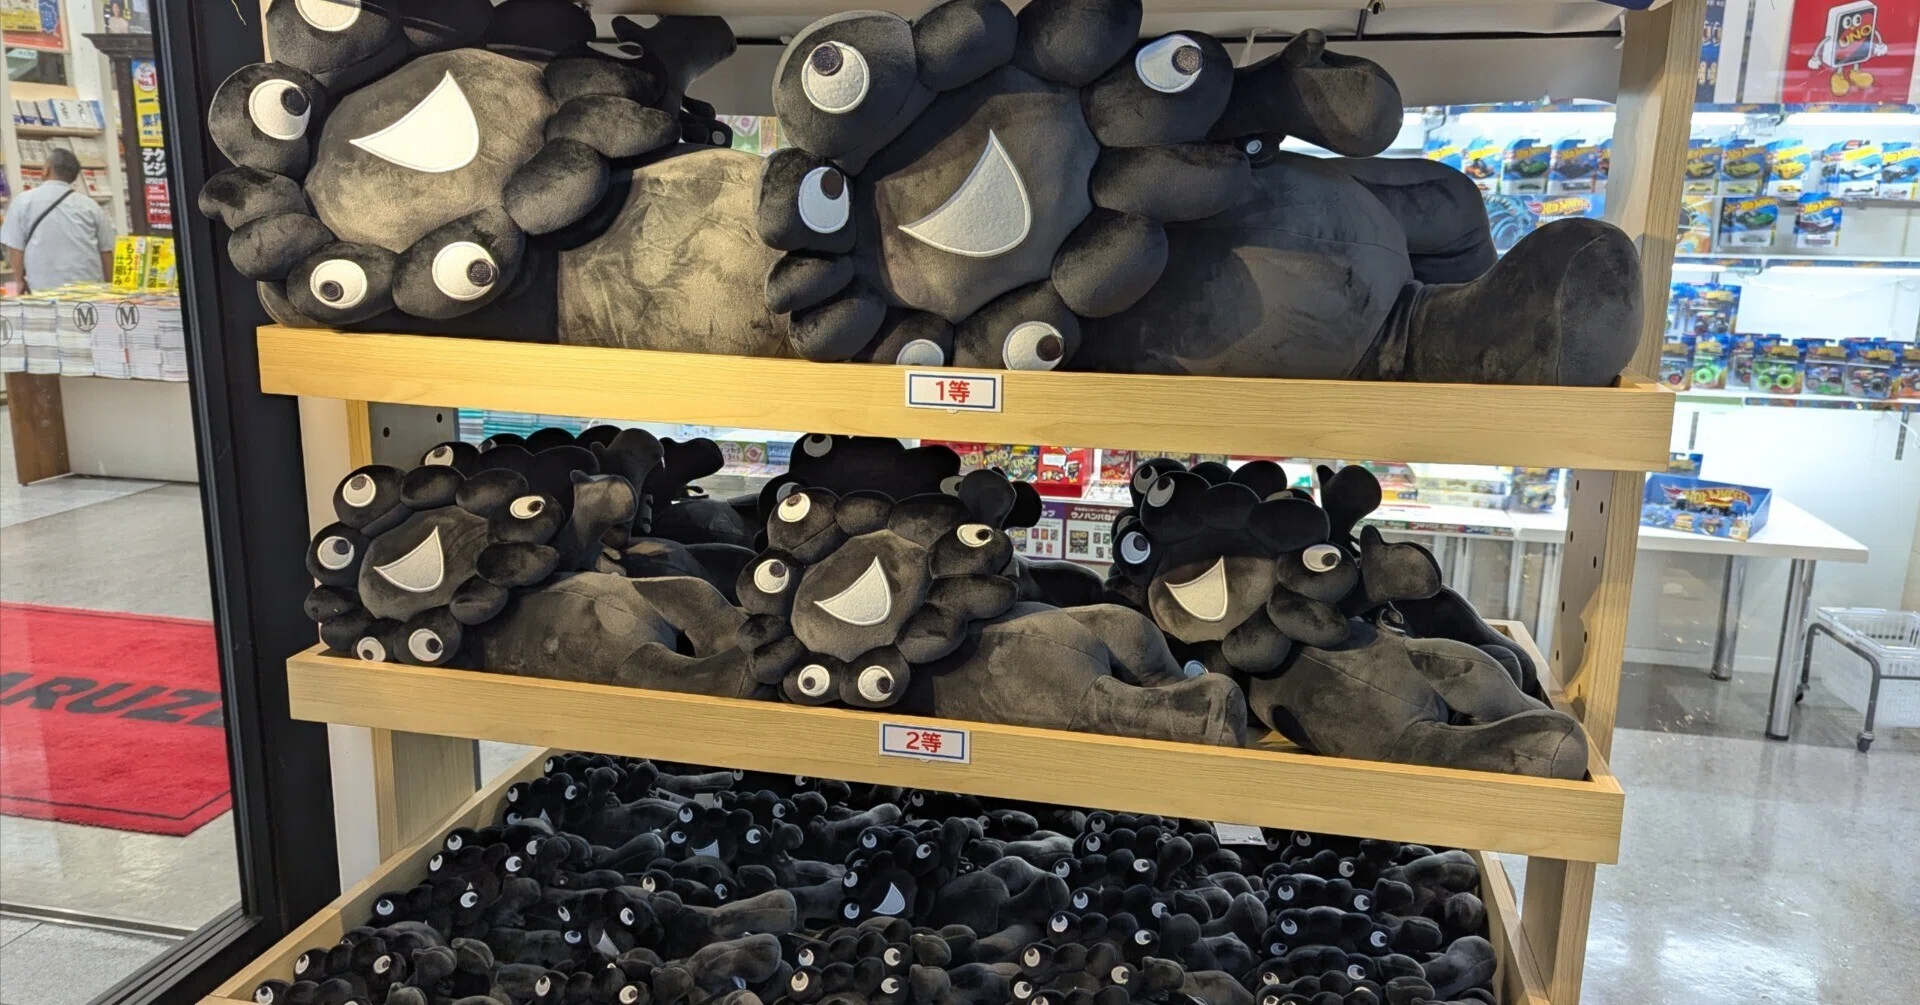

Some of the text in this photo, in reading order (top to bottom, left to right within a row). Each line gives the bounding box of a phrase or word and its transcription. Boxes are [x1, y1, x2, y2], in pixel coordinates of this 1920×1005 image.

[1839, 24, 1872, 48] UNO
[936, 380, 970, 403] 1等
[906, 732, 942, 753] 2等
